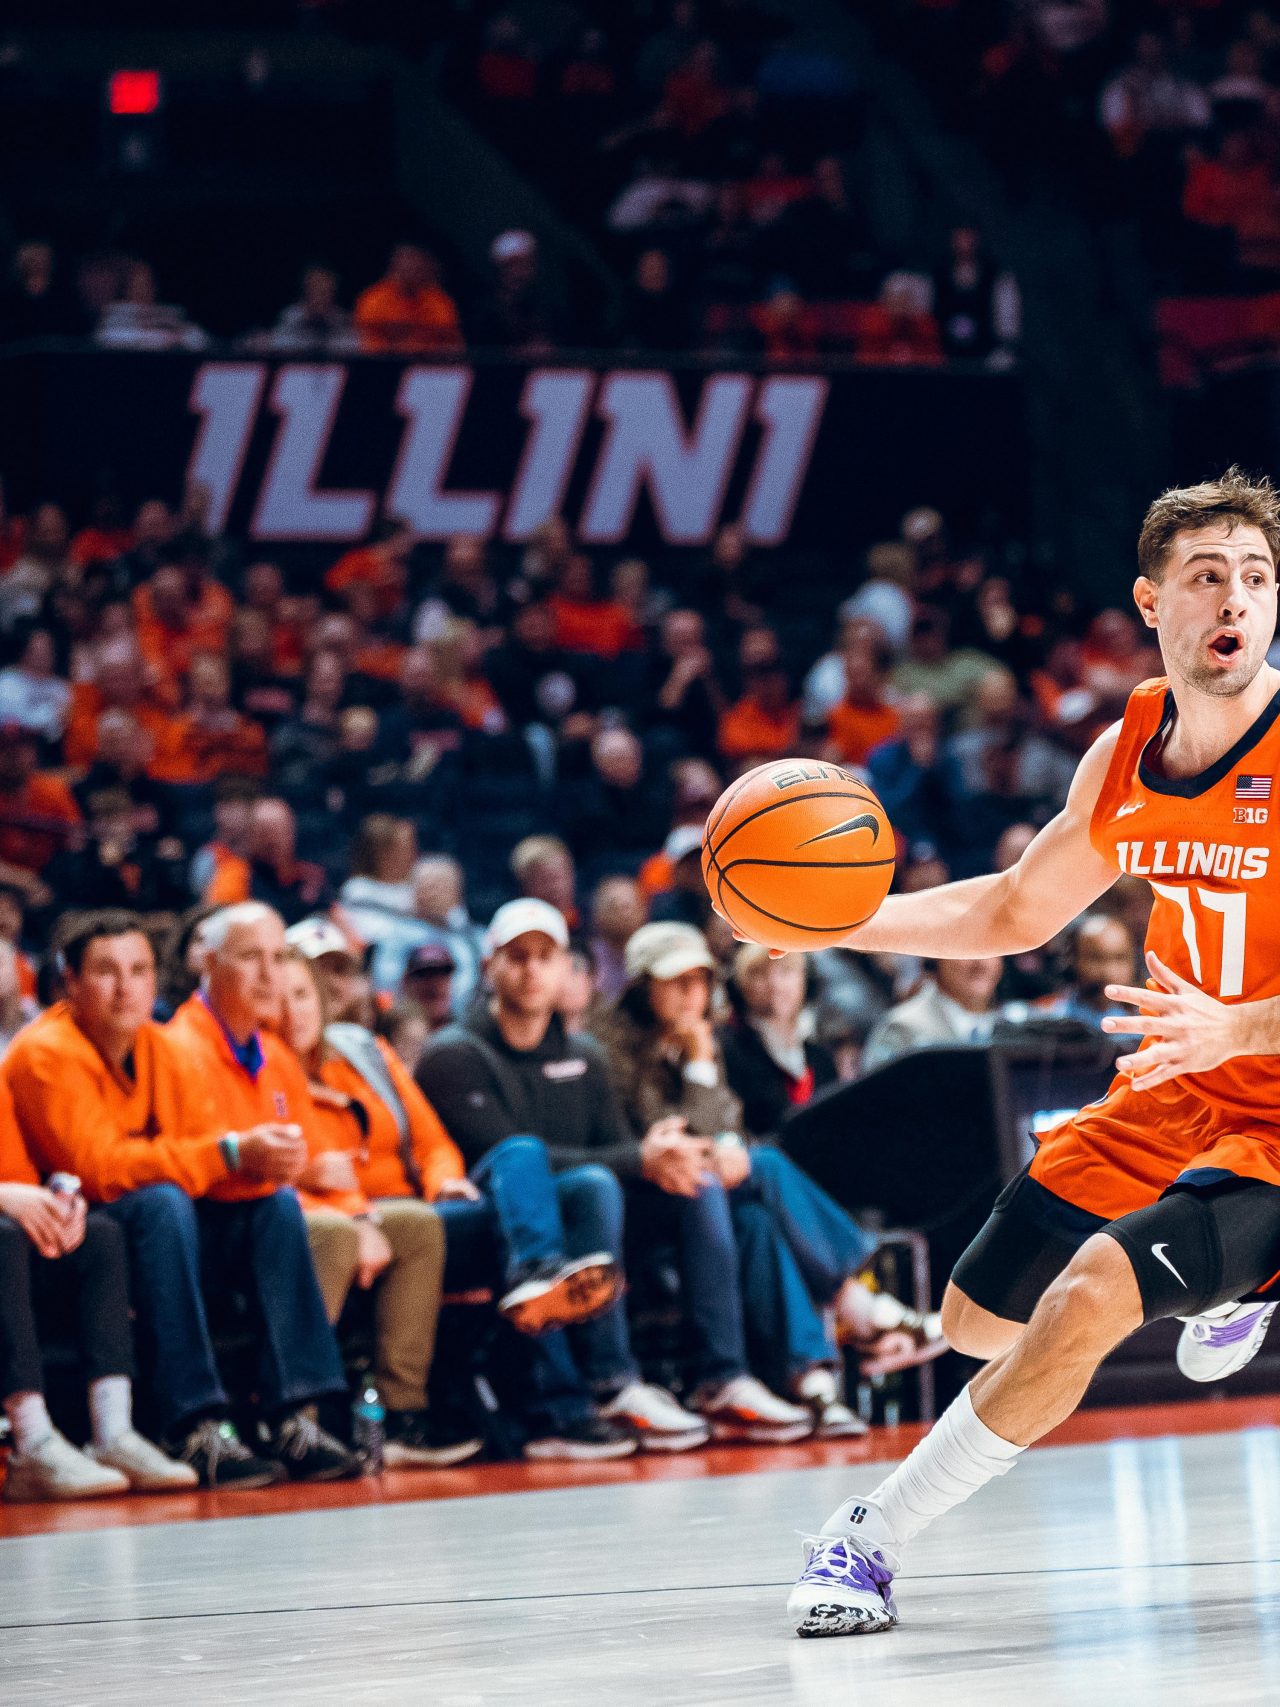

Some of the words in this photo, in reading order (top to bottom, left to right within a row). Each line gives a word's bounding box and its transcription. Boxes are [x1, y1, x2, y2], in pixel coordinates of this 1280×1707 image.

[188, 362, 830, 546] ILLINI
[771, 766, 869, 791] ELITE
[1116, 840, 1270, 880] ILLINOIS
